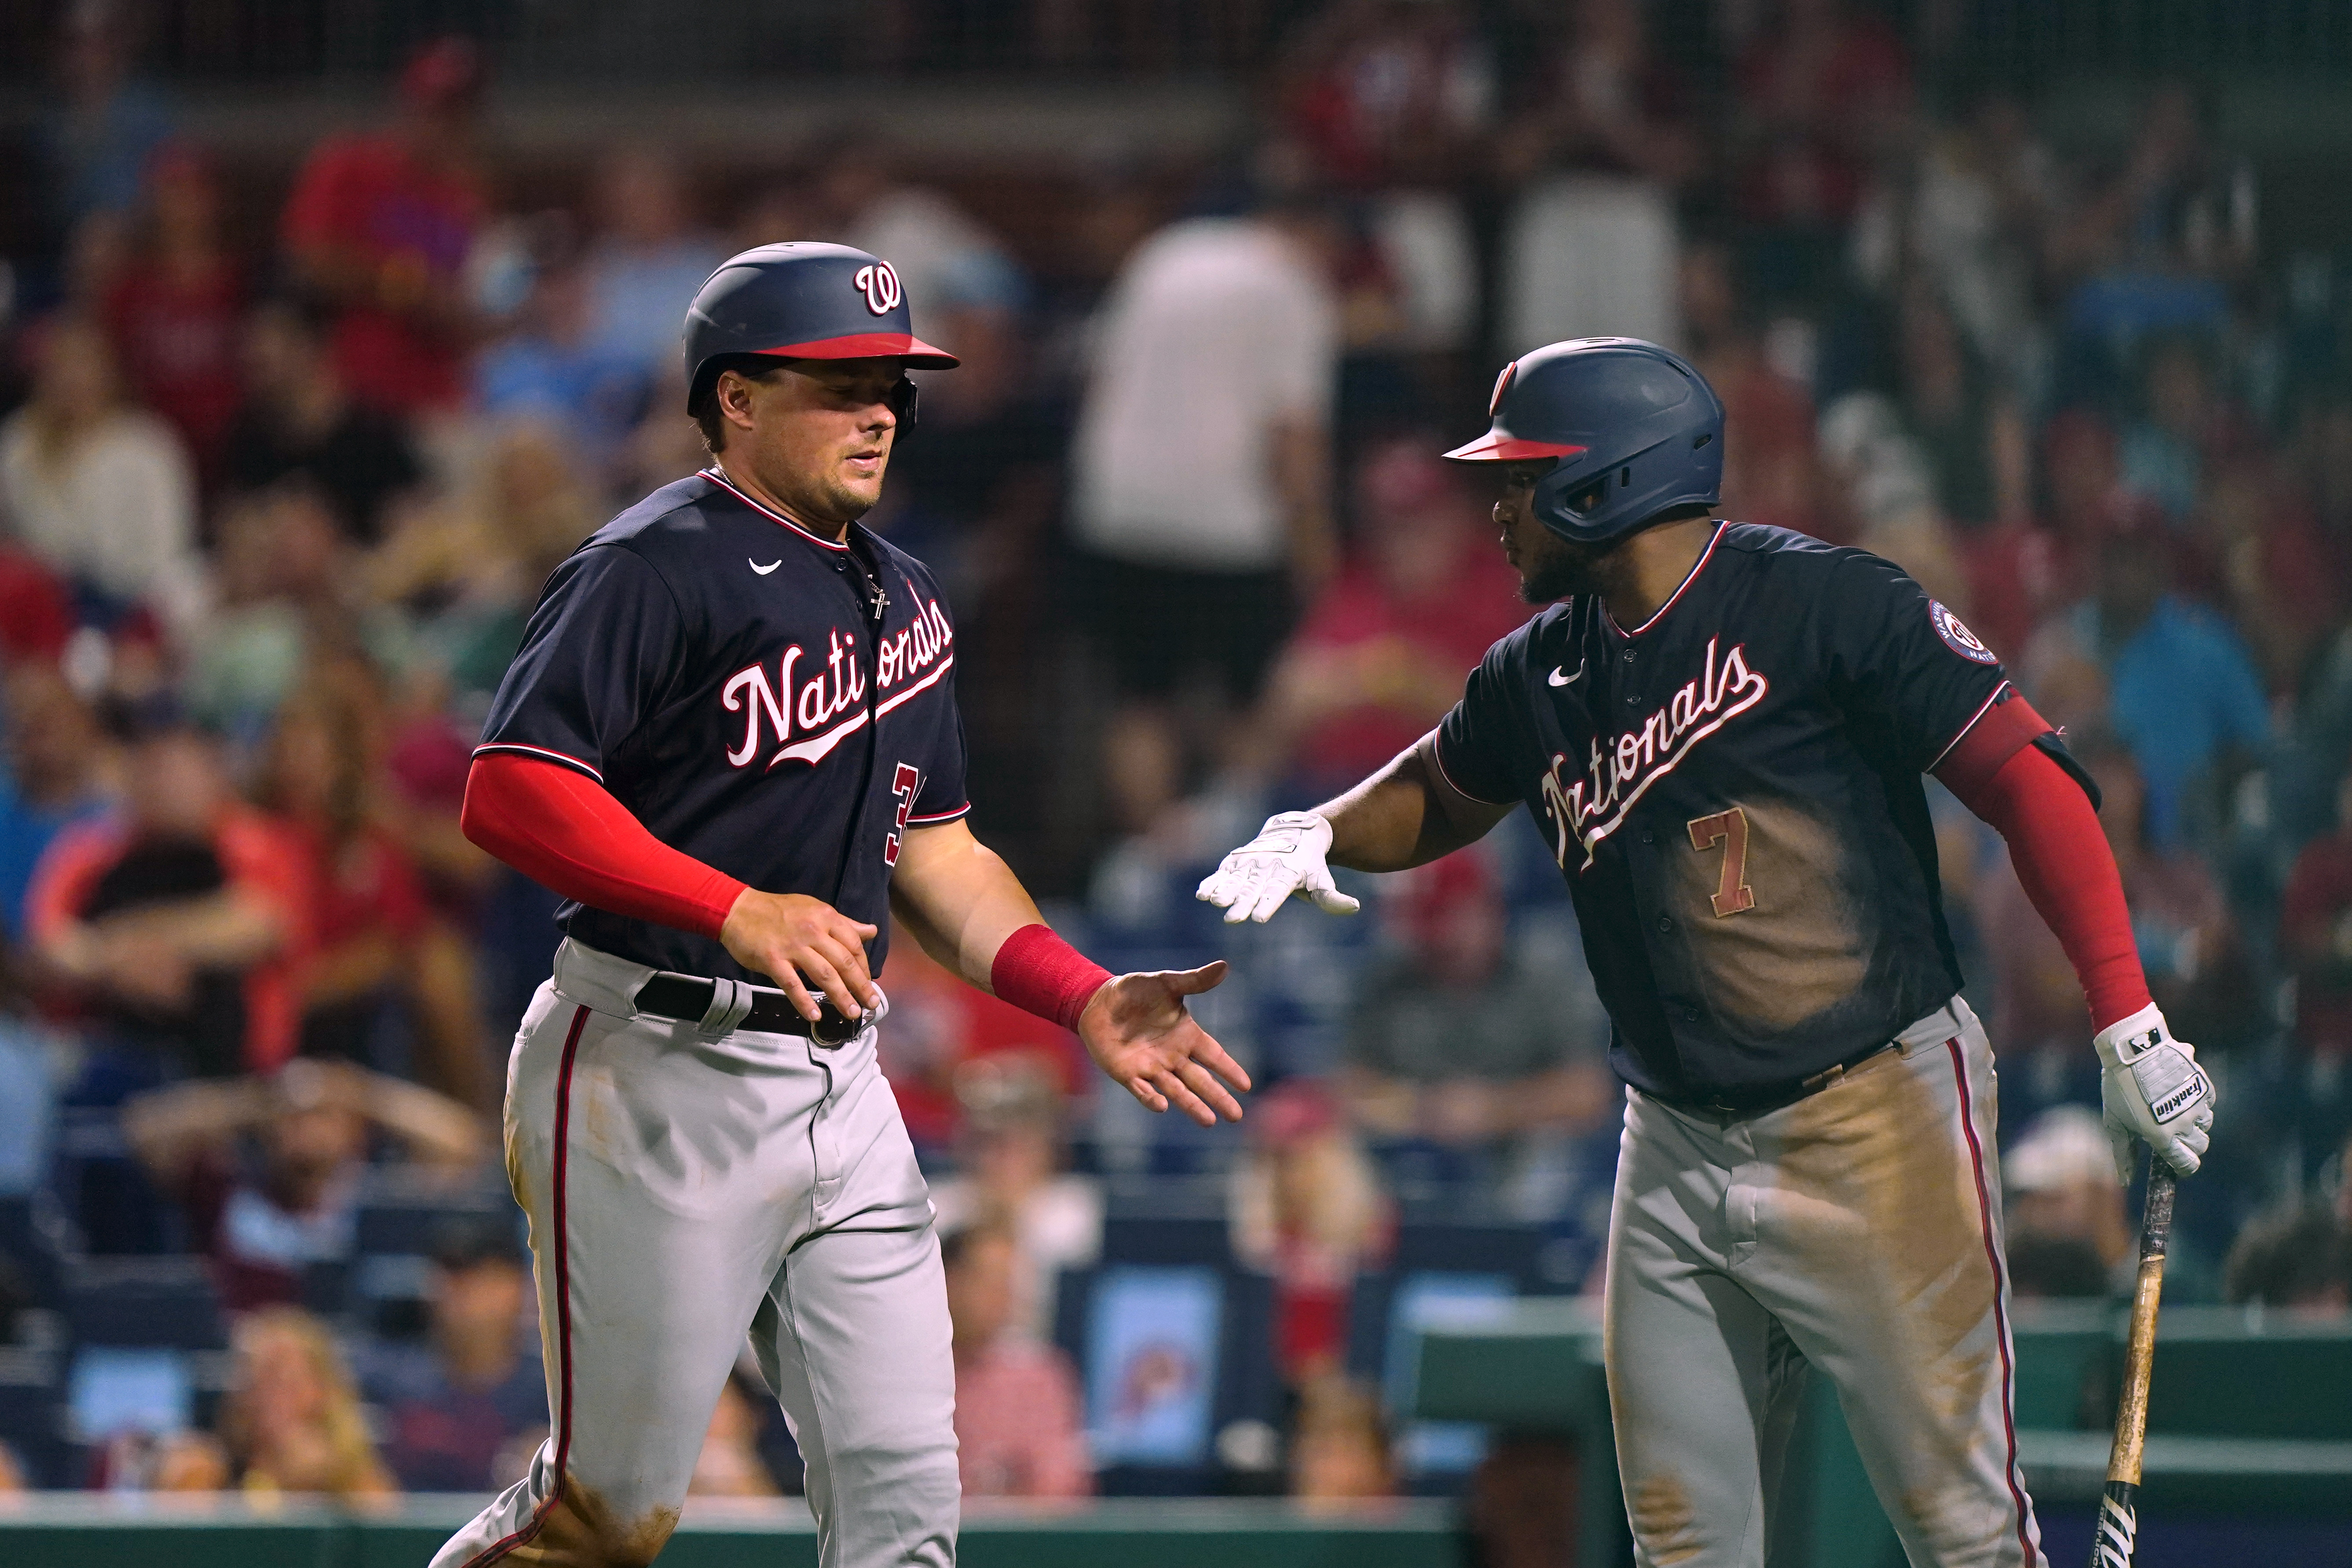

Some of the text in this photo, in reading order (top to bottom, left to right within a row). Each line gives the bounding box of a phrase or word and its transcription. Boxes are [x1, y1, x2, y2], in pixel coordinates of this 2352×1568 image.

[854, 260, 901, 316] W
[721, 579, 953, 771] Nationals
[1541, 632, 1769, 873] Nationals
[885, 761, 927, 867] 3
[1686, 807, 1755, 918] 7
[2156, 1076, 2202, 1116] franklin
[2092, 1506, 2105, 1568] marucc
